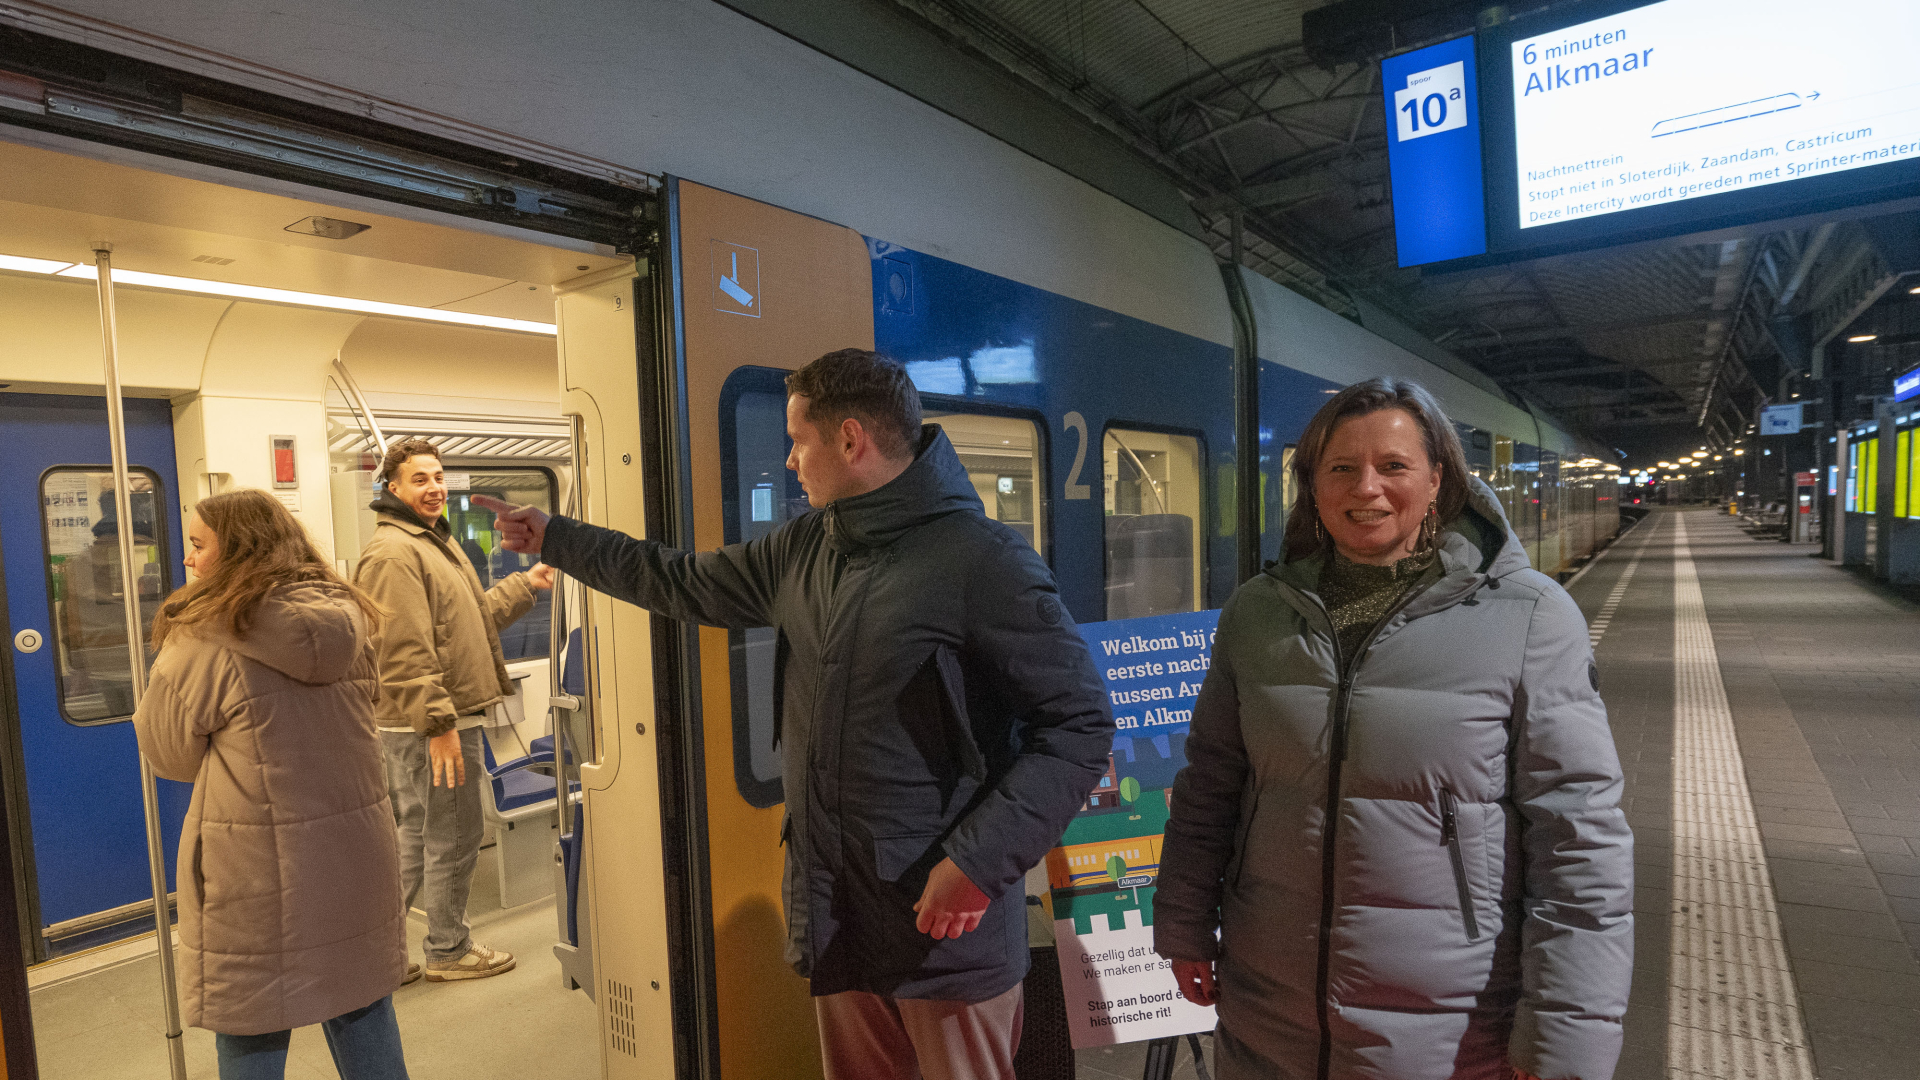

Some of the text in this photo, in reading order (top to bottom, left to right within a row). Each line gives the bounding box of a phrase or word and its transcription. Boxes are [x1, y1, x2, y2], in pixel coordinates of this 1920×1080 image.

[1523, 29, 1626, 65] 6 minuten
[1410, 76, 1431, 86] spoor
[1524, 47, 1654, 97] Alkmaar
[1528, 127, 1872, 202] Stopt niet in Sloterdijk, Zaandam, Castricum
[1528, 154, 1624, 182] Nachtnettrein
[1529, 209, 1561, 222] Deze
[1566, 196, 1624, 215] Intercity
[1629, 186, 1673, 204] wordt
[1678, 175, 1743, 198] gereden
[1748, 166, 1780, 182] met
[1063, 411, 1090, 500] 2
[1101, 636, 1179, 656] Welkom
[1181, 629, 1206, 650] bij
[1106, 661, 1163, 680] eerste
[1110, 686, 1174, 705] tussen
[1115, 715, 1139, 730] en
[1121, 877, 1148, 886] Alkmaar
[1081, 950, 1125, 963] Gezellig
[1127, 946, 1145, 958] dat
[1083, 969, 1101, 980] We
[1104, 964, 1141, 977] maken
[1144, 962, 1155, 971] er
[1088, 1000, 1114, 1012] Stap
[1117, 997, 1137, 1008] aan
[1139, 989, 1173, 1004] boord
[1090, 1006, 1172, 1028] historische rit!
